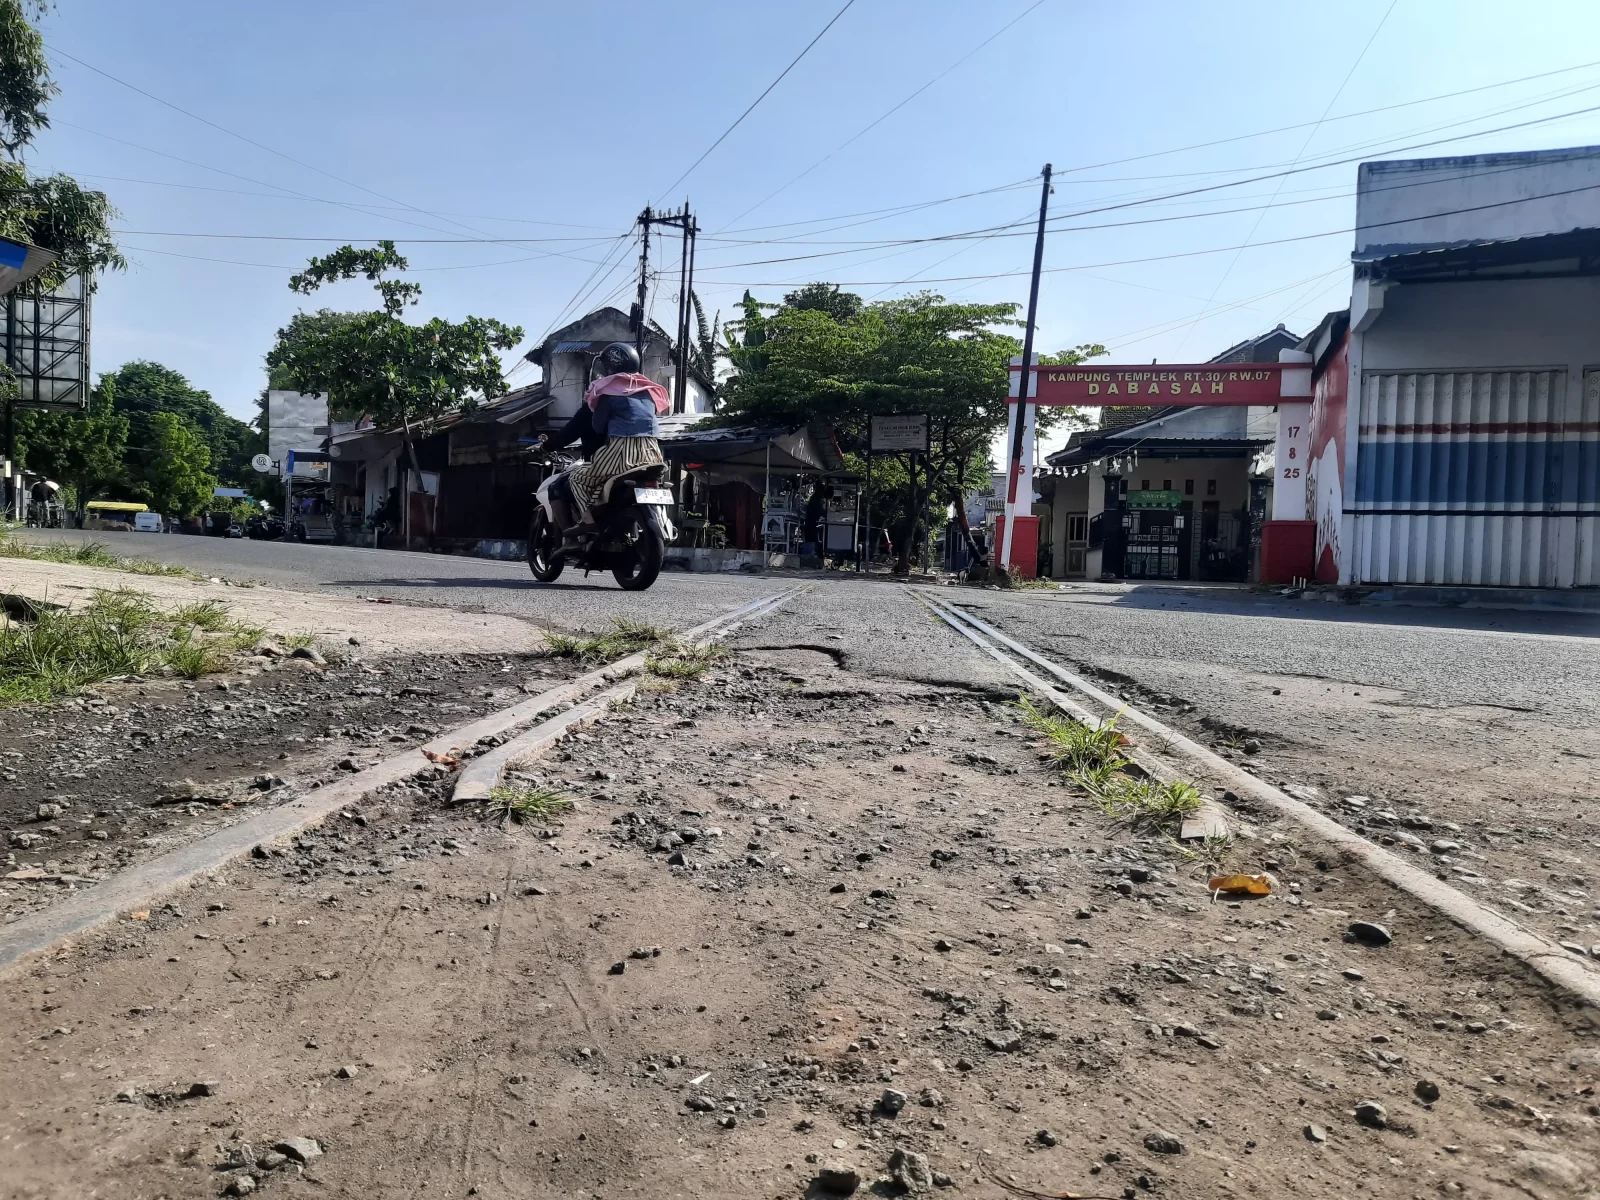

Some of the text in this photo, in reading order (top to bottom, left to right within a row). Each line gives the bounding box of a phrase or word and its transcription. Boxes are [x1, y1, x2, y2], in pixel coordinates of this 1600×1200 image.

[1048, 373, 1110, 382] KAMPUNG
[1117, 372, 1177, 381] TEMPLEK
[1088, 382, 1224, 395] DABASAH
[1288, 426, 1300, 438] 17
[1289, 447, 1296, 460] 8
[1284, 467, 1300, 479] 25
